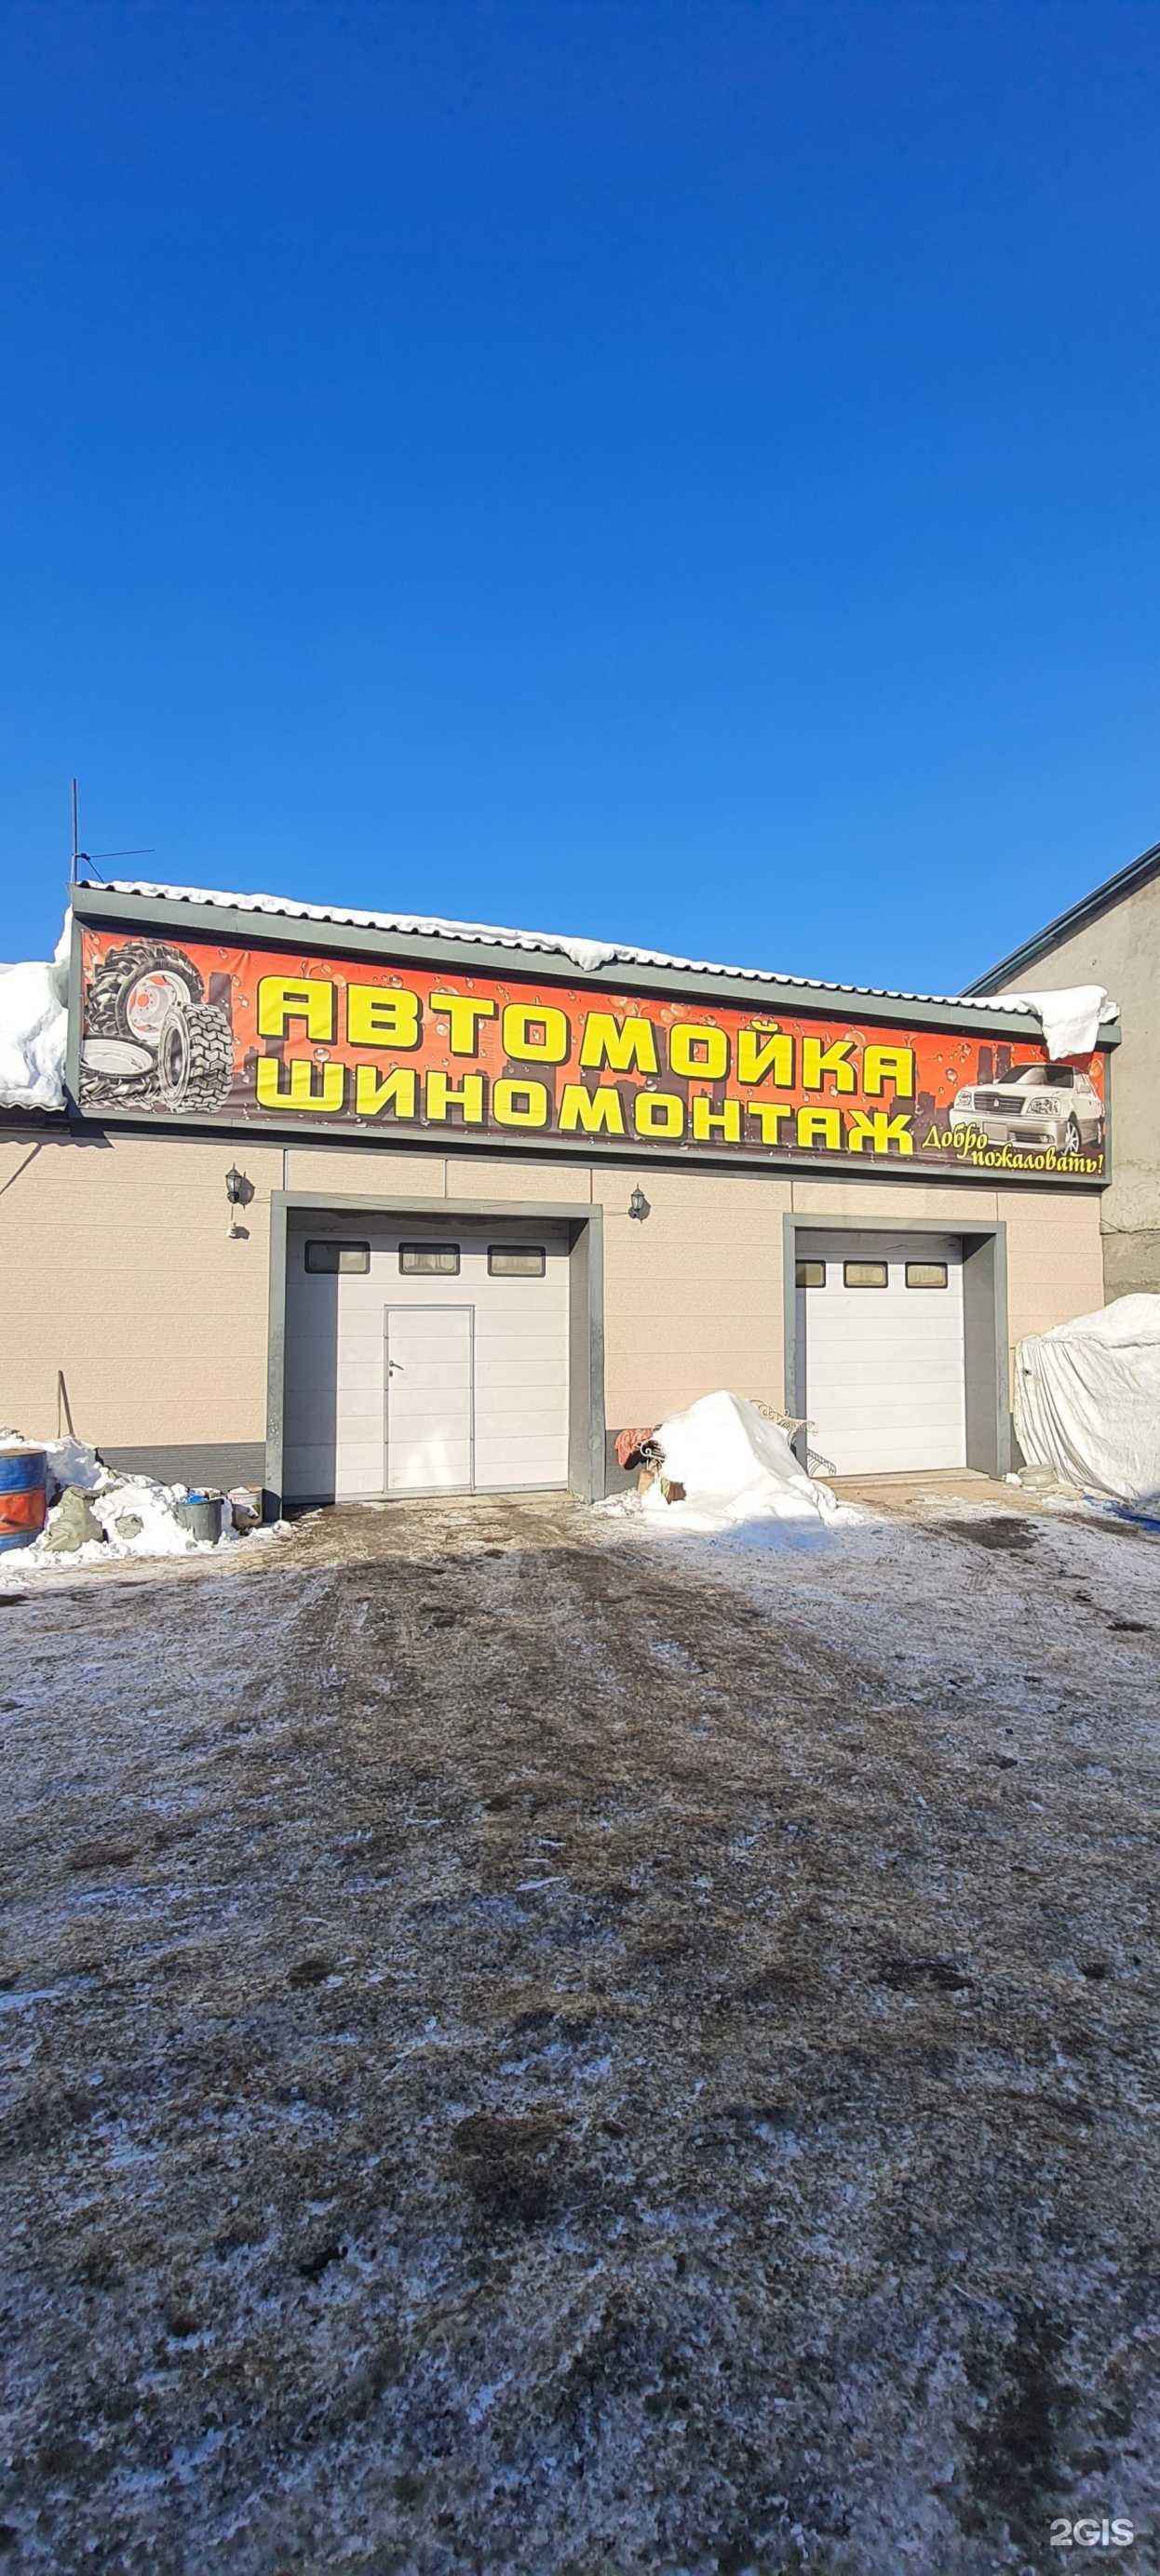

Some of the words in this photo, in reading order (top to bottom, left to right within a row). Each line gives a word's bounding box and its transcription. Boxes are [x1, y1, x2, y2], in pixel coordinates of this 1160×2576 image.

[258, 975, 913, 1098] АВТОМОЙКА
[256, 1056, 913, 1156] ШИНОМОНТАЖ
[923, 1121, 989, 1159] Добро
[970, 1143, 1104, 1174] пожаловать!
